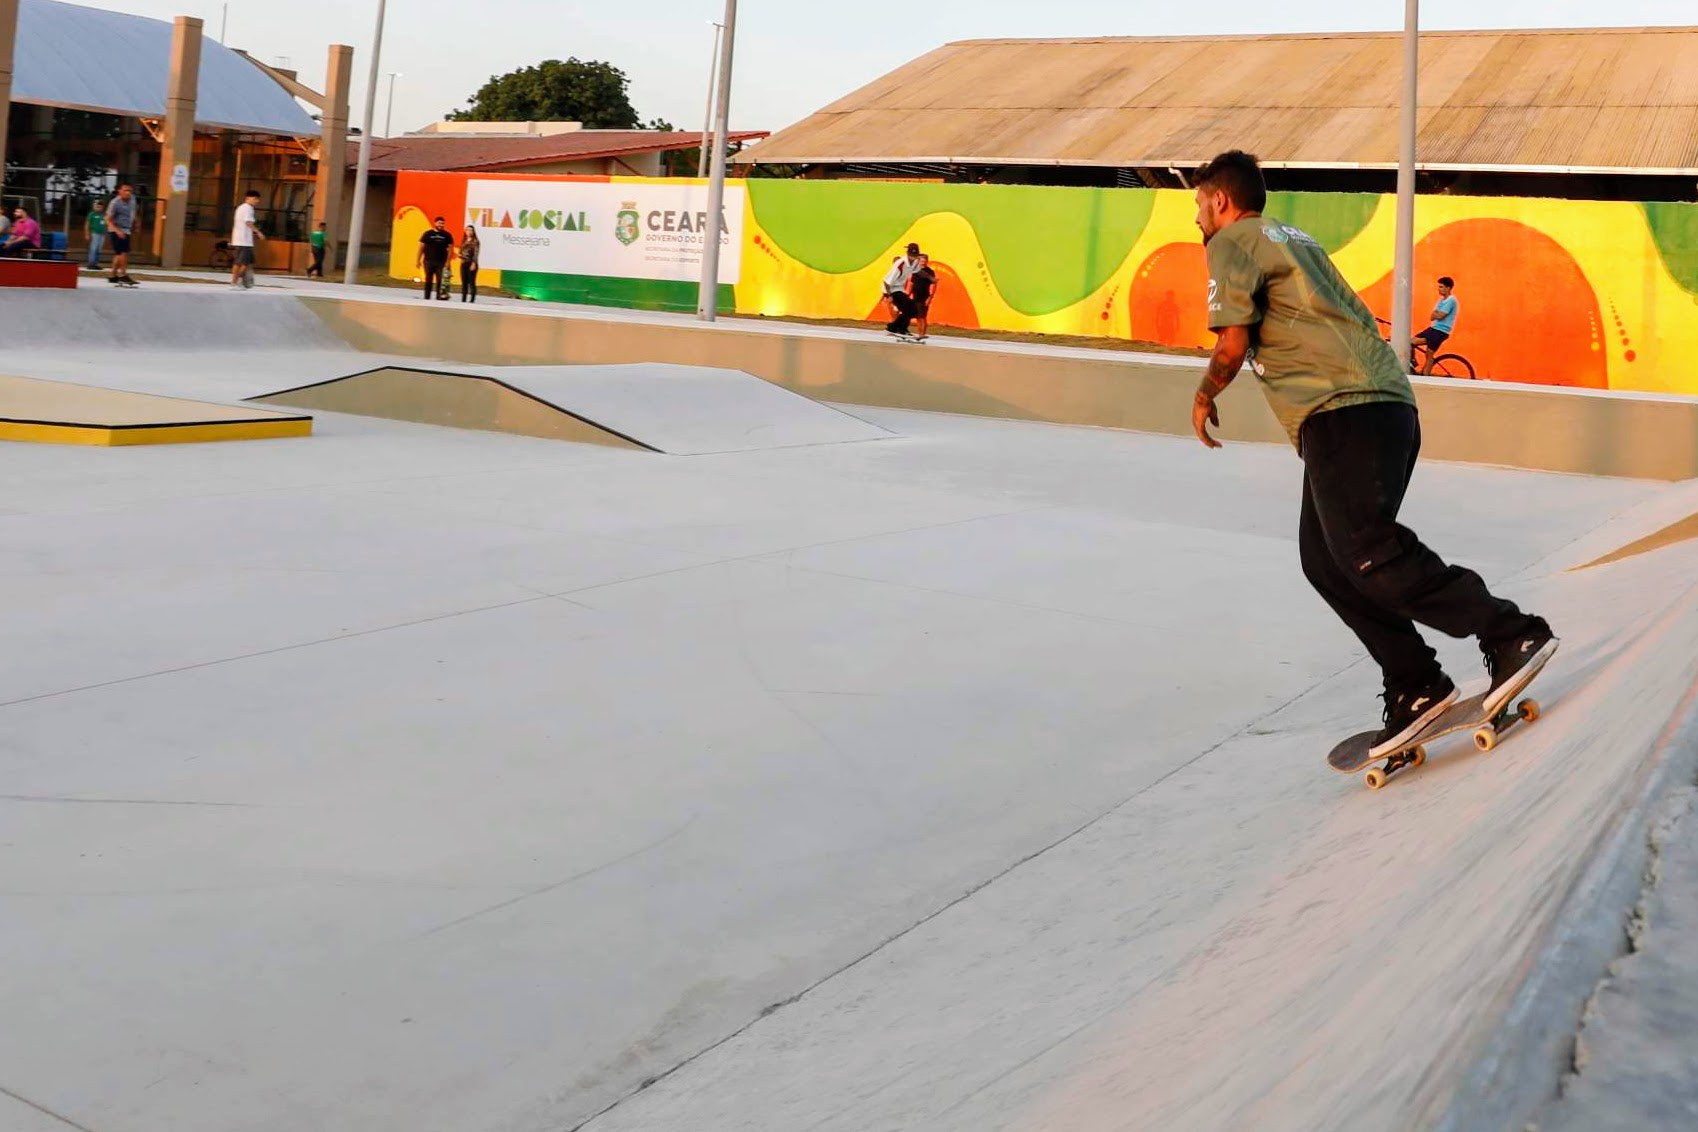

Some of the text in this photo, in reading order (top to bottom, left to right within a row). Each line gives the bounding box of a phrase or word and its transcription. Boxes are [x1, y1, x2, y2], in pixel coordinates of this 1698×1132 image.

[503, 234, 550, 248] Messejana
[645, 234, 682, 243] GOVERNO
[684, 235, 696, 243] DO
